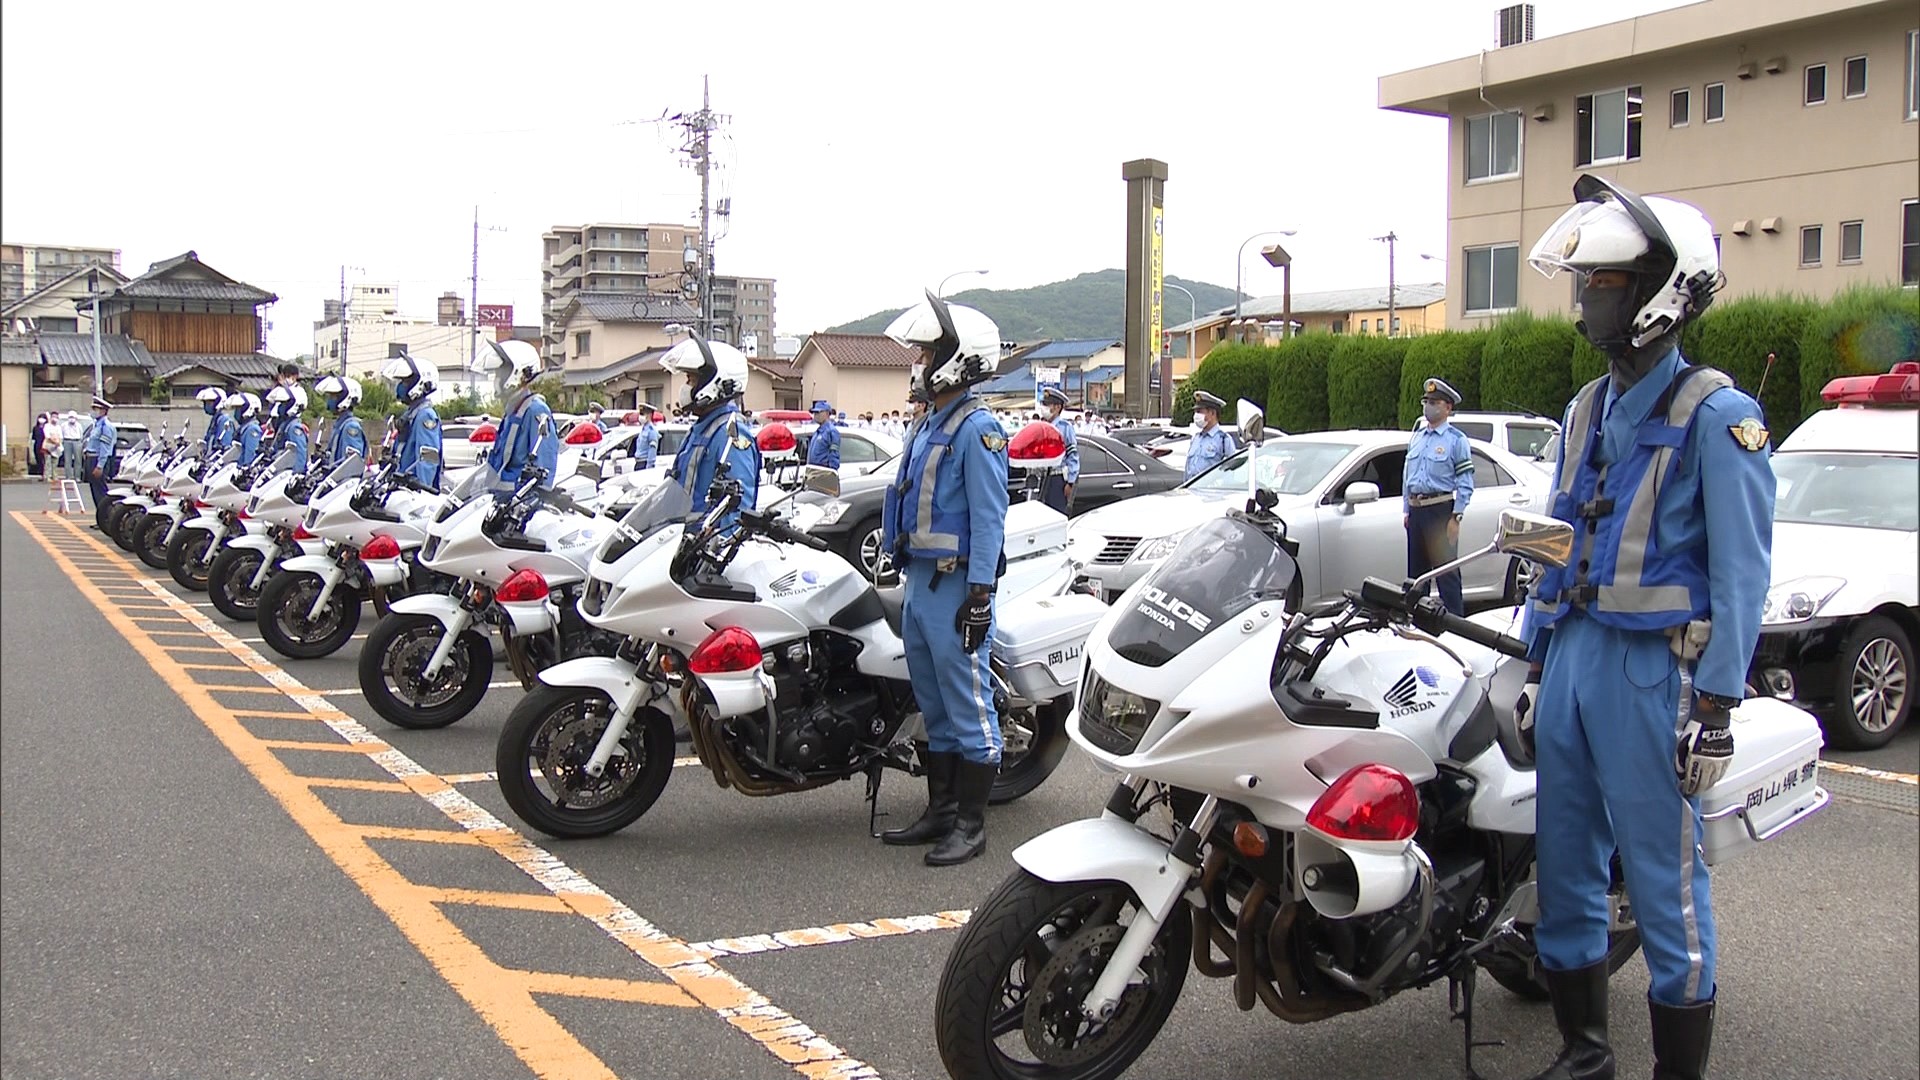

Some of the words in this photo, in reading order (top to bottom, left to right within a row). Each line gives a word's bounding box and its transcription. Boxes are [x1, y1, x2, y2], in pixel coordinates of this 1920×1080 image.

[772, 588, 808, 599] HONDA
[1138, 584, 1211, 632] POLICE
[1138, 603, 1176, 631] HONDA
[1390, 700, 1436, 719] HONDA
[1746, 759, 1816, 809] 岡山県警
